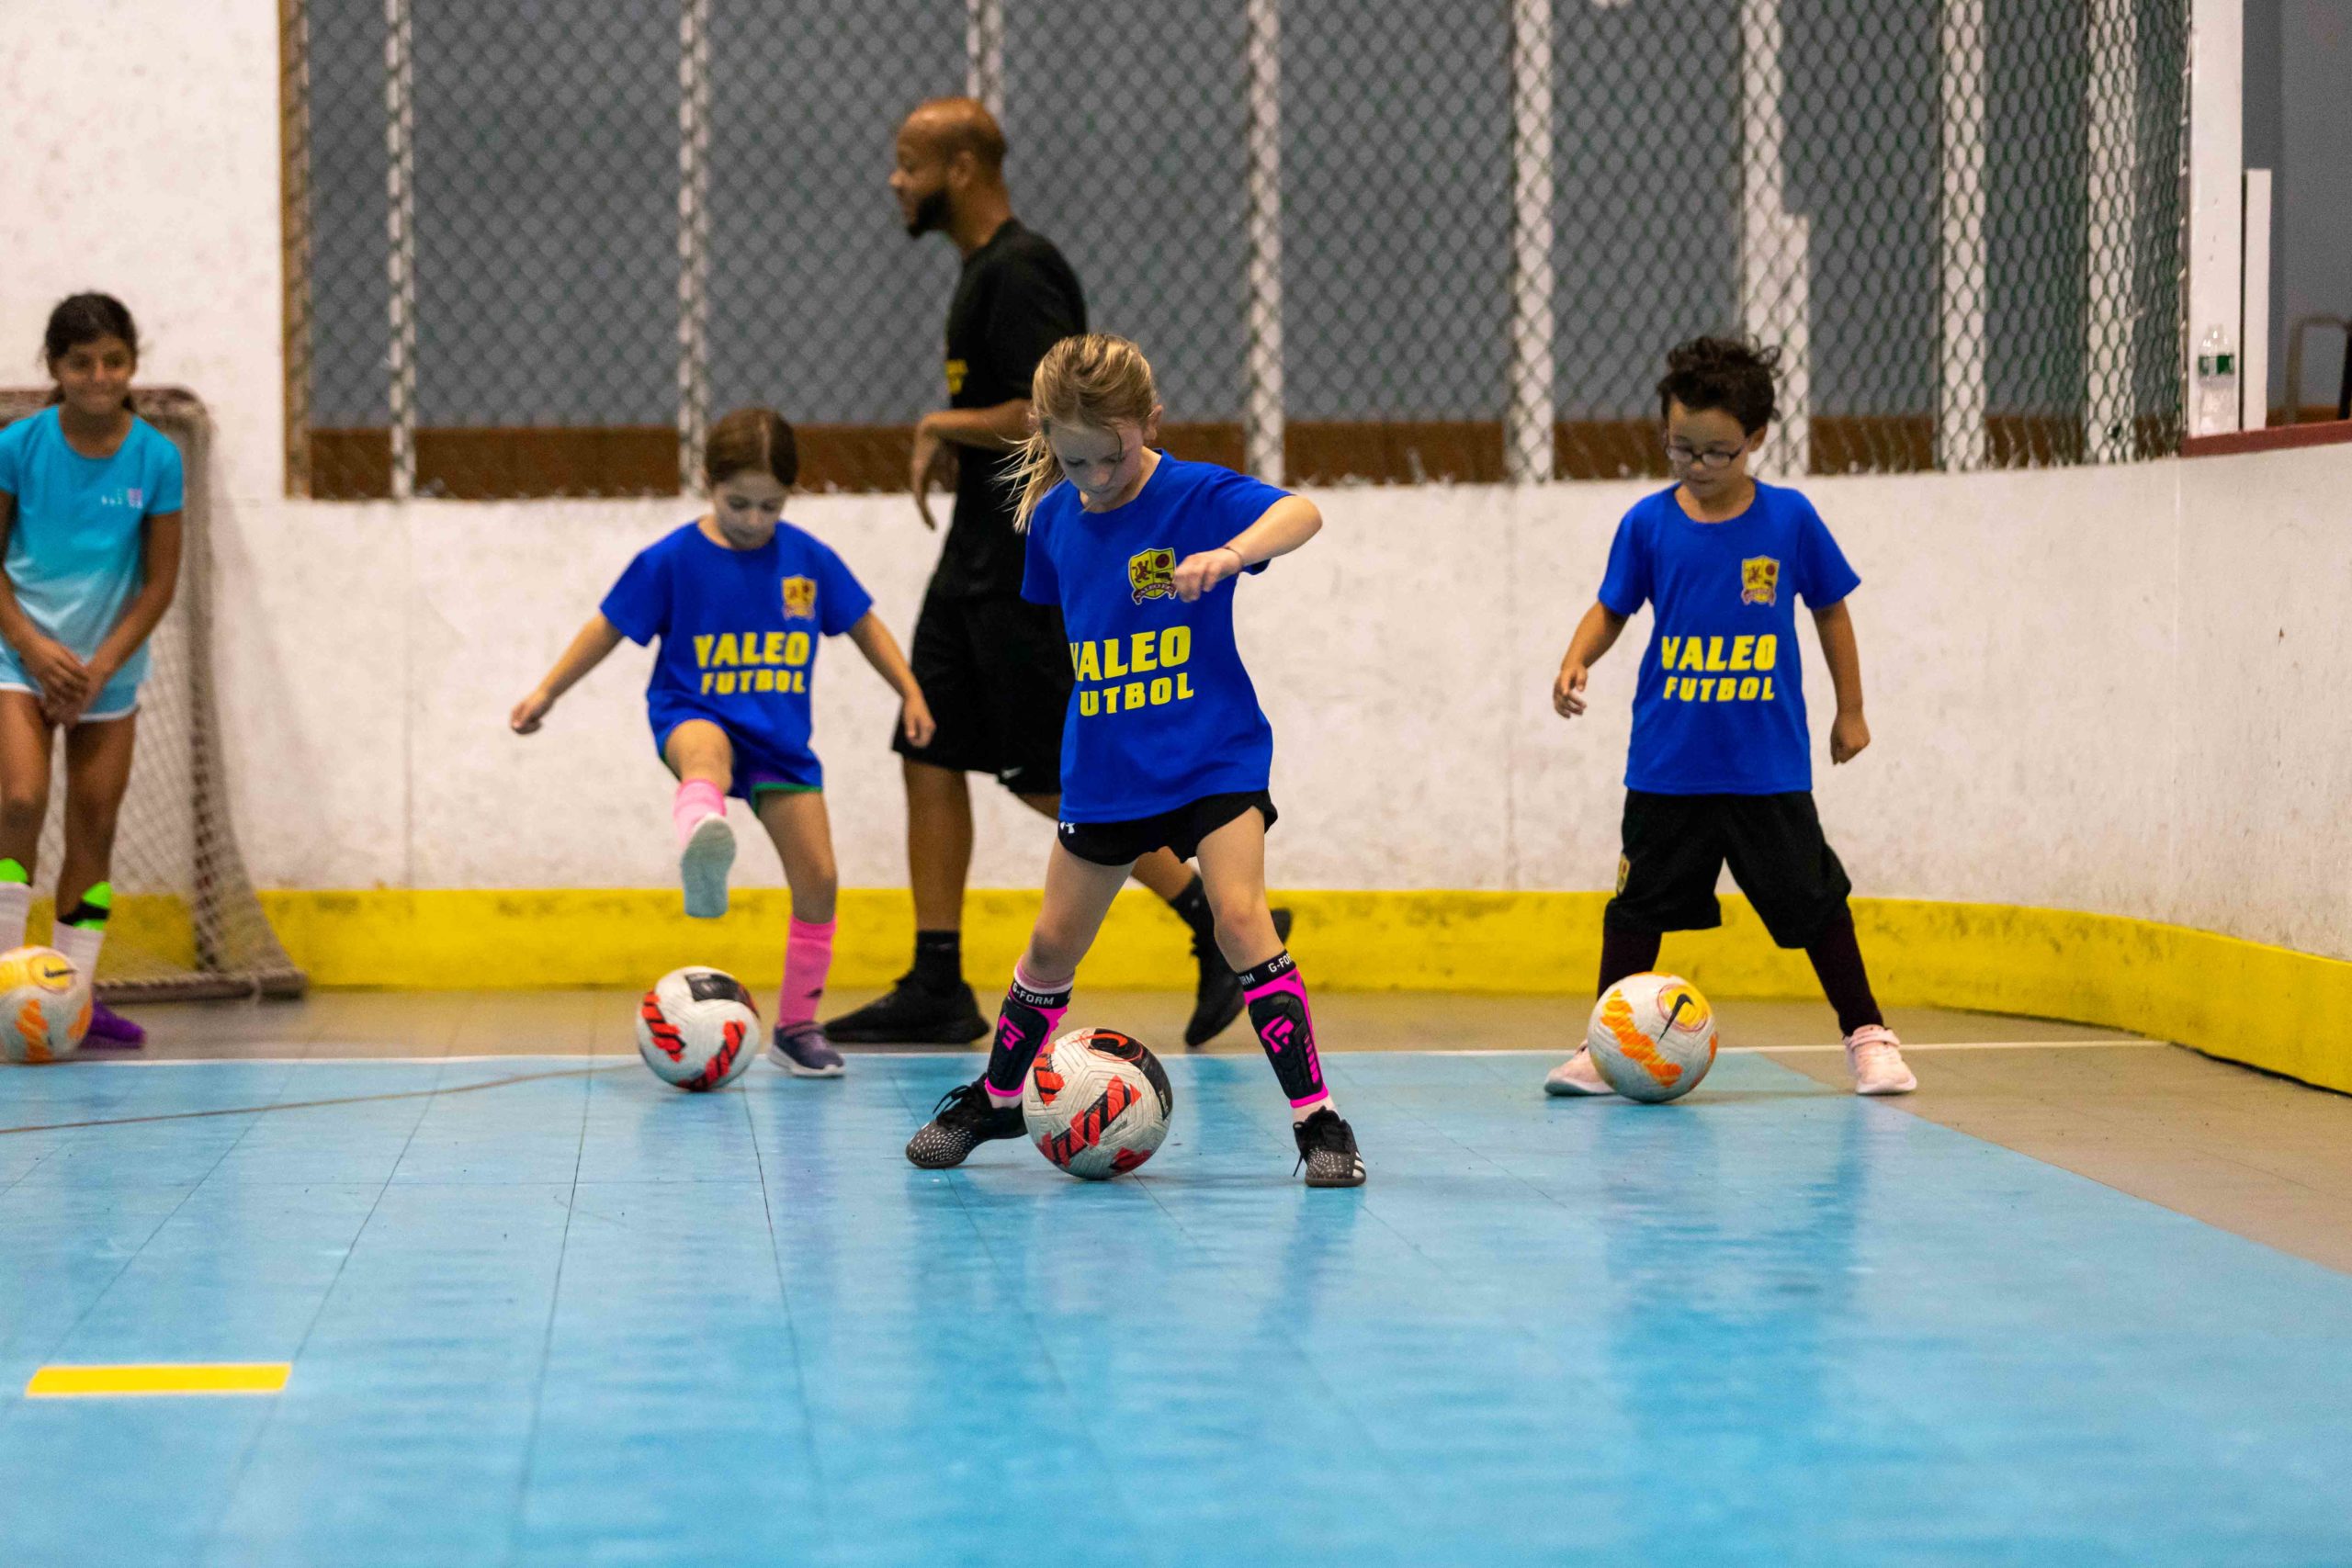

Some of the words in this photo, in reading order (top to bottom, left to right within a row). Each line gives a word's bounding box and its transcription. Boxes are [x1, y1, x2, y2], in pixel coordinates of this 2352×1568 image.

[693, 631, 810, 668] VALEO
[1661, 634, 1778, 671] VALEO
[700, 669, 806, 695] FUTBOL
[1080, 672, 1194, 716] UTBOL
[1663, 676, 1775, 702] FUTBOL
[1268, 953, 1292, 973] G-FO
[1012, 982, 1055, 1006] G-FORM
